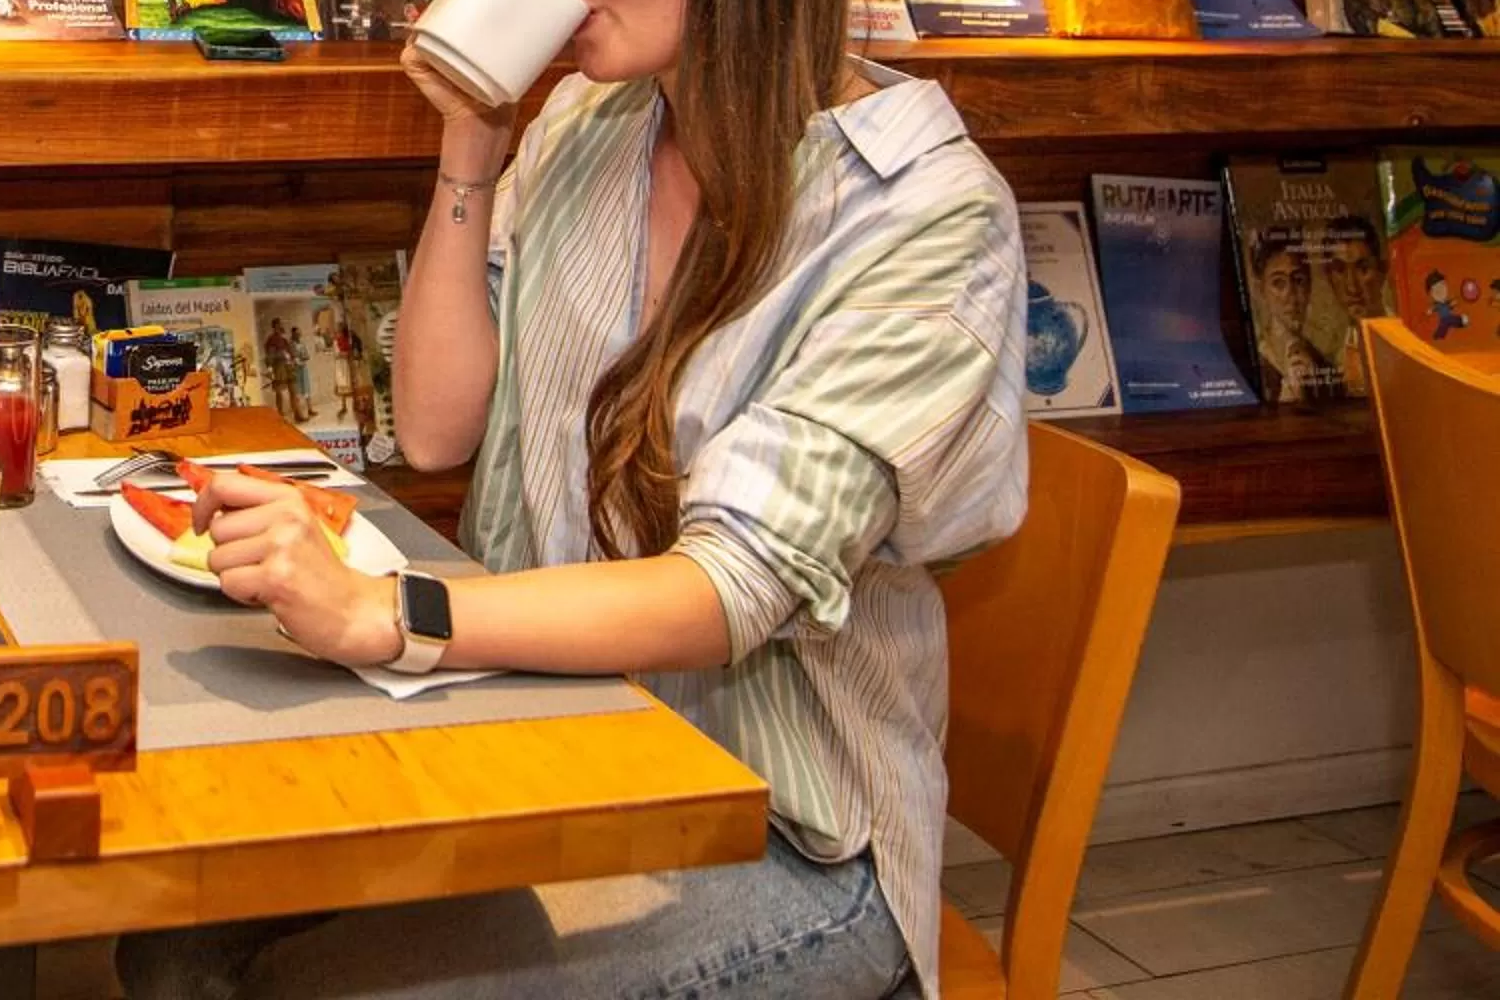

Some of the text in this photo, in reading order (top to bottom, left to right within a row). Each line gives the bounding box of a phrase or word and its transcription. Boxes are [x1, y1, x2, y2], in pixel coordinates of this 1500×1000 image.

[28, 0, 109, 13] Profesional
[1102, 184, 1218, 216] RUTA ARTE
